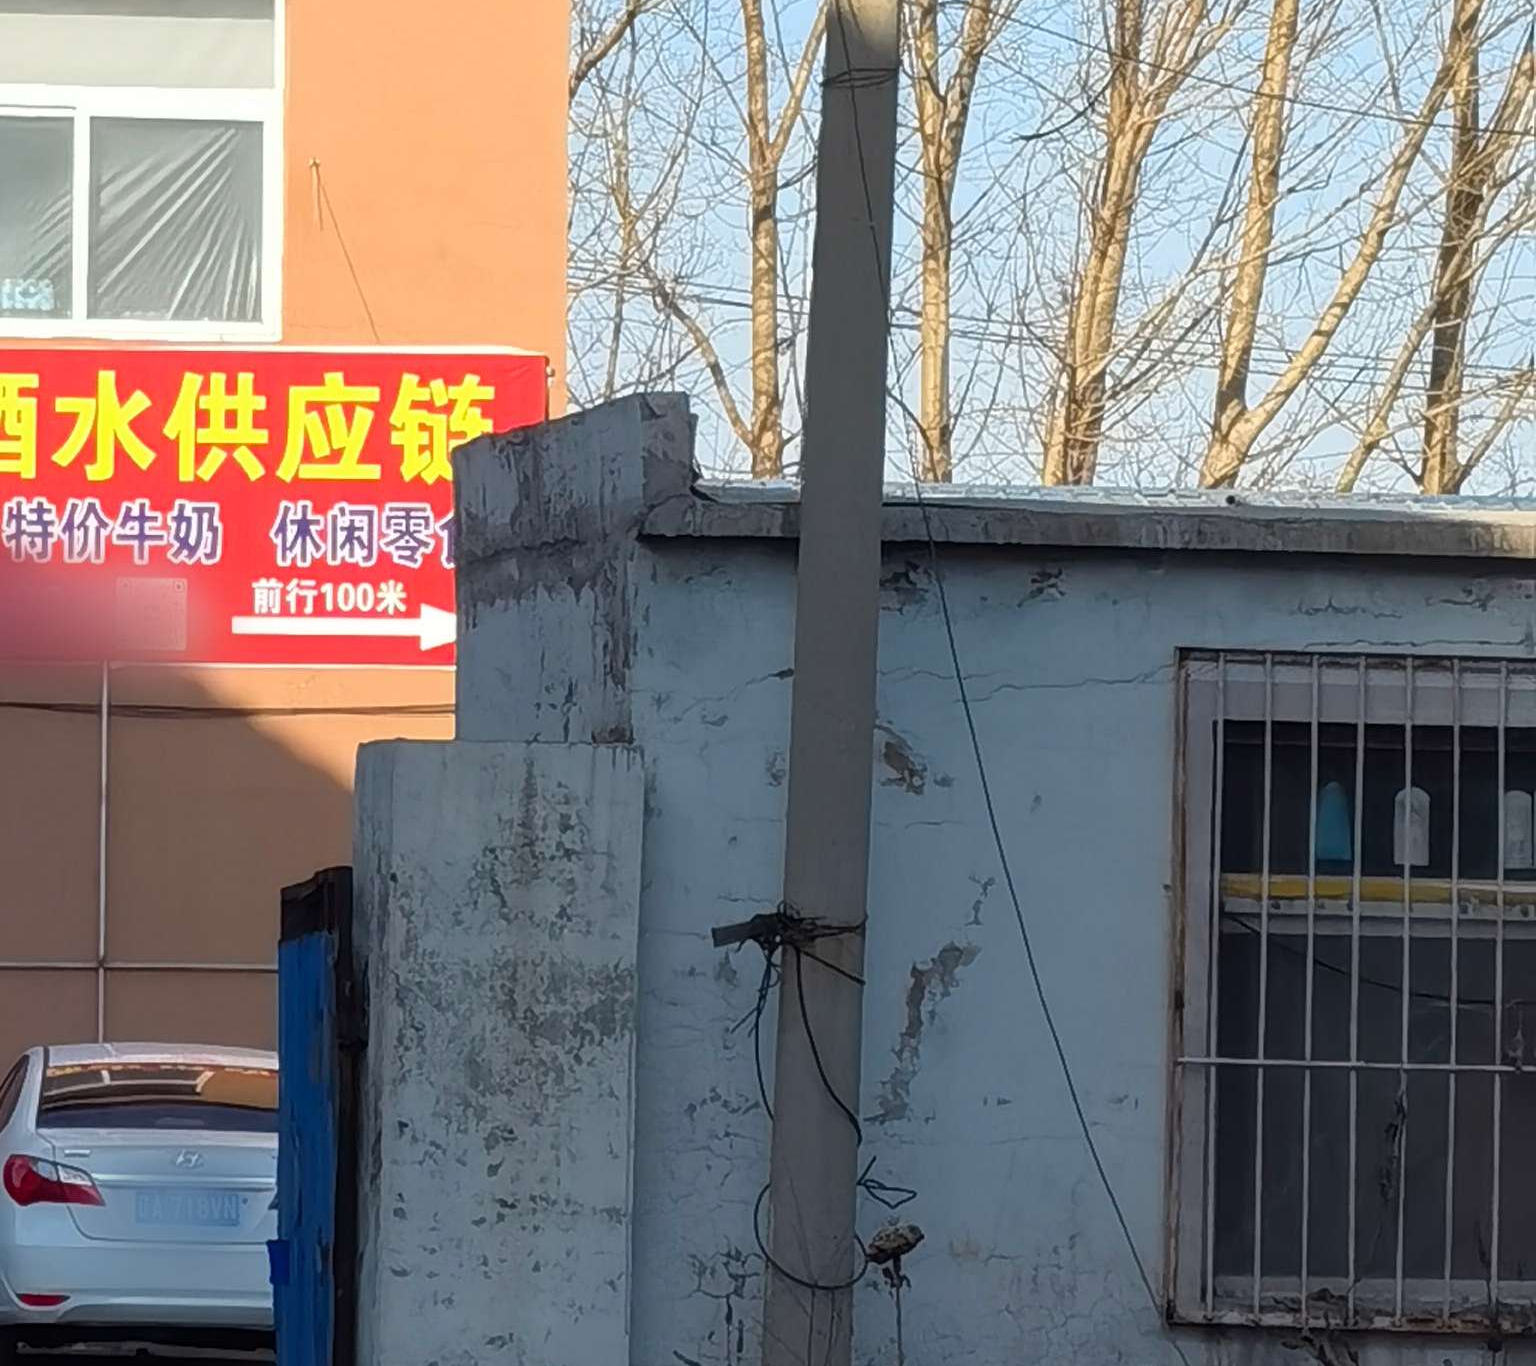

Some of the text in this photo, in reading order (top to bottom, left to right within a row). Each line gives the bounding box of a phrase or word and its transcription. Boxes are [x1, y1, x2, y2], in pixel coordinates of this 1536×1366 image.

[1, 498, 221, 565] 特价牛奶
[250, 578, 408, 615] 前行100米
